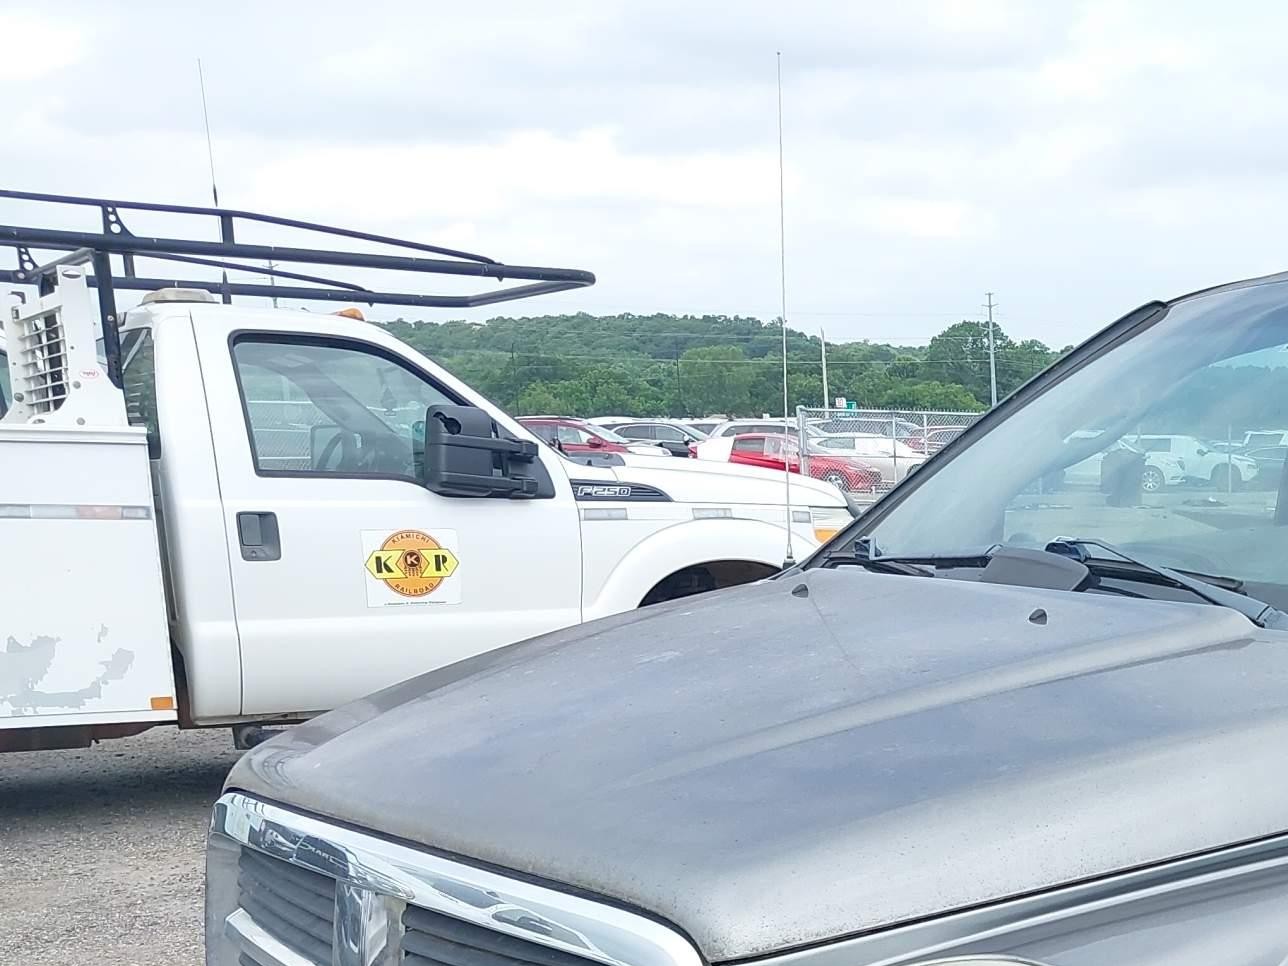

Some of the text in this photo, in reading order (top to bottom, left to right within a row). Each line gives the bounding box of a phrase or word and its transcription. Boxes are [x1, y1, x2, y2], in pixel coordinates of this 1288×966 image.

[391, 532, 430, 545] KIAMICHI
[374, 555, 394, 574] K
[434, 554, 449, 572] R
[394, 582, 435, 594] RAILROAD
